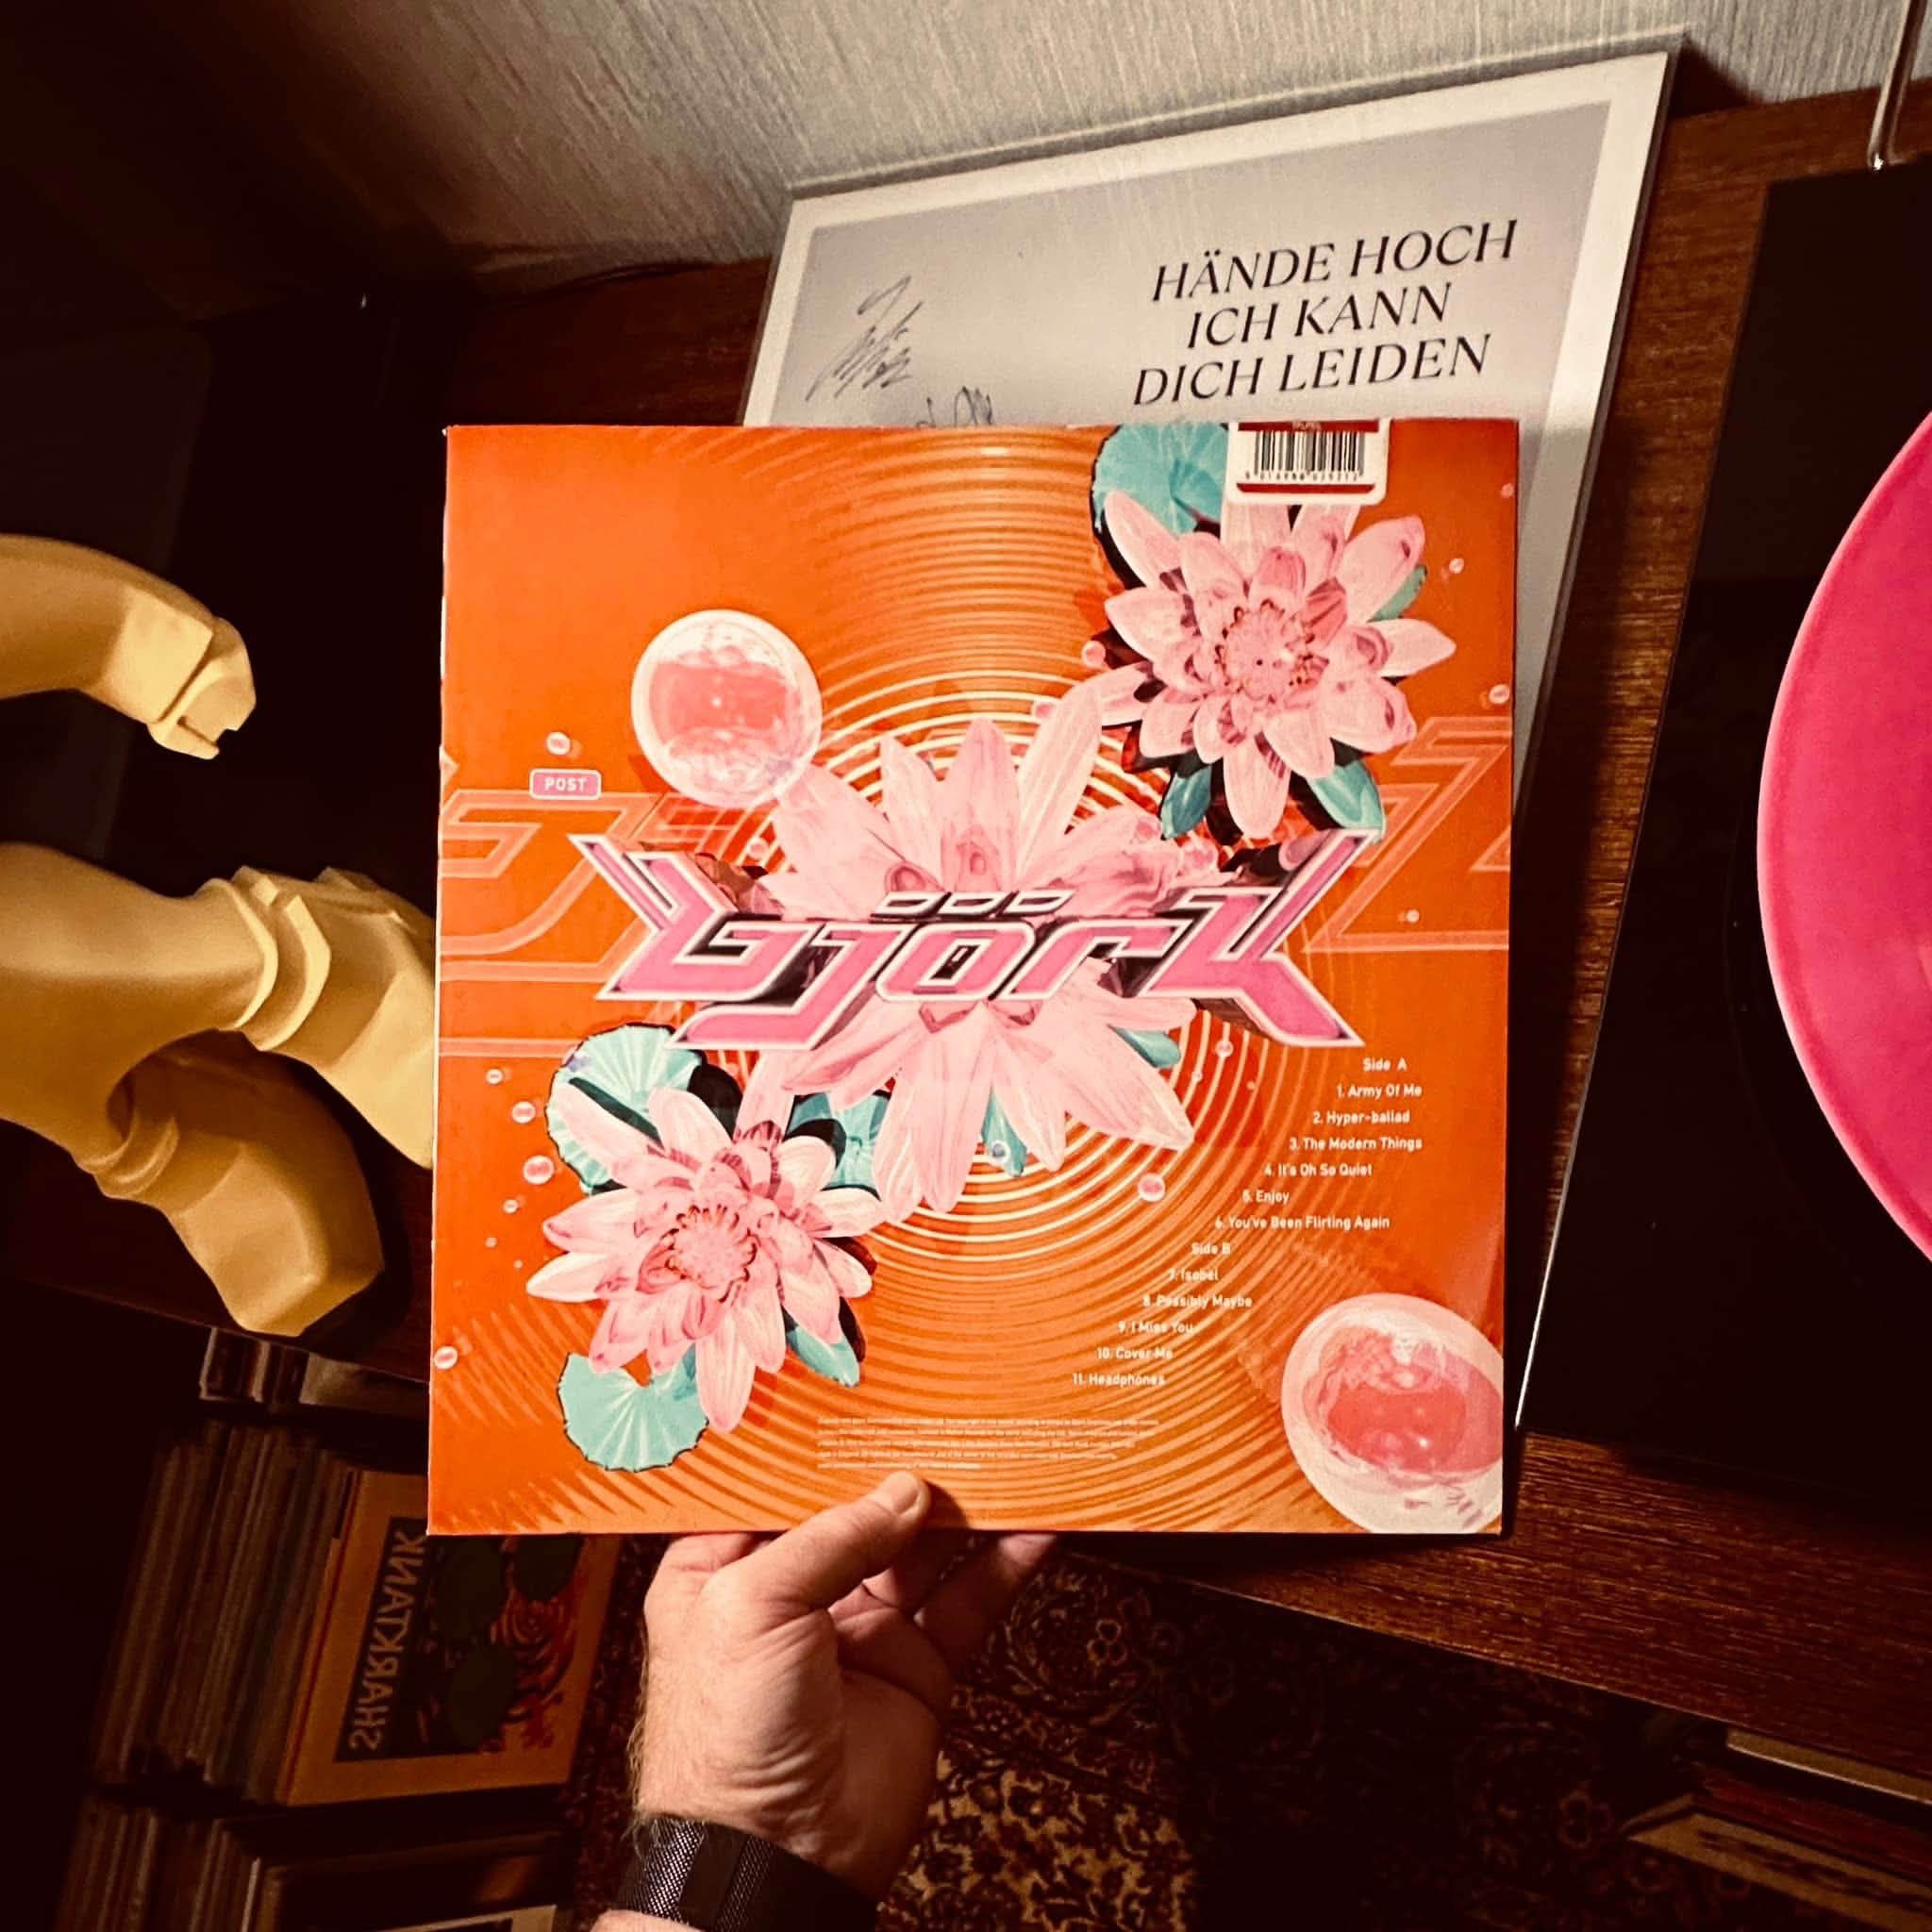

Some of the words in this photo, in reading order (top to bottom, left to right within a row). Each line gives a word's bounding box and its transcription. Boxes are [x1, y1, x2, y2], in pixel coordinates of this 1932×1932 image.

[1152, 249, 1335, 303] HÄNDE
[1349, 219, 1518, 277] HOCH
[1187, 302, 1279, 349] ICH
[1293, 282, 1452, 338] KANN
[1133, 357, 1264, 407] DICH
[1278, 333, 1491, 392] LEIDEN
[544, 776, 588, 792] POST
[1362, 1058, 1391, 1072] Side
[1397, 1058, 1407, 1072] A
[1337, 1085, 1345, 1098] 1.
[1347, 1085, 1382, 1099] Army
[1386, 1084, 1400, 1097] Of
[1403, 1084, 1423, 1097] Me
[1312, 1111, 1324, 1124] 2.
[1325, 1110, 1410, 1126] Hyper-ballad
[1290, 1137, 1299, 1150] 3.
[1303, 1137, 1325, 1150] The
[1328, 1137, 1376, 1150] Modern
[1380, 1137, 1423, 1152] Things
[1264, 1163, 1274, 1177] 4.
[1278, 1163, 1297, 1177] It's
[1300, 1163, 1317, 1176] Oh
[1319, 1163, 1336, 1176] So
[1339, 1163, 1373, 1177] Quiet
[1242, 1189, 1252, 1204] 5.
[1255, 1189, 1290, 1206] Enjoy
[1214, 1216, 1224, 1230] 6.
[1228, 1215, 1267, 1229] You've
[1271, 1215, 1302, 1229] Been
[1306, 1215, 1351, 1232] Flirting
[1354, 1215, 1391, 1231] Again
[1191, 1241, 1218, 1256] Side
[1222, 1241, 1231, 1255] B
[1157, 1294, 1208, 1309] Possibly
[1212, 1293, 1254, 1308] Maybe
[1140, 1321, 1168, 1334] Miss
[1172, 1320, 1194, 1334] You
[1116, 1346, 1151, 1359] Cover
[1155, 1346, 1174, 1359] Me
[1089, 1372, 1166, 1388] Headphones
